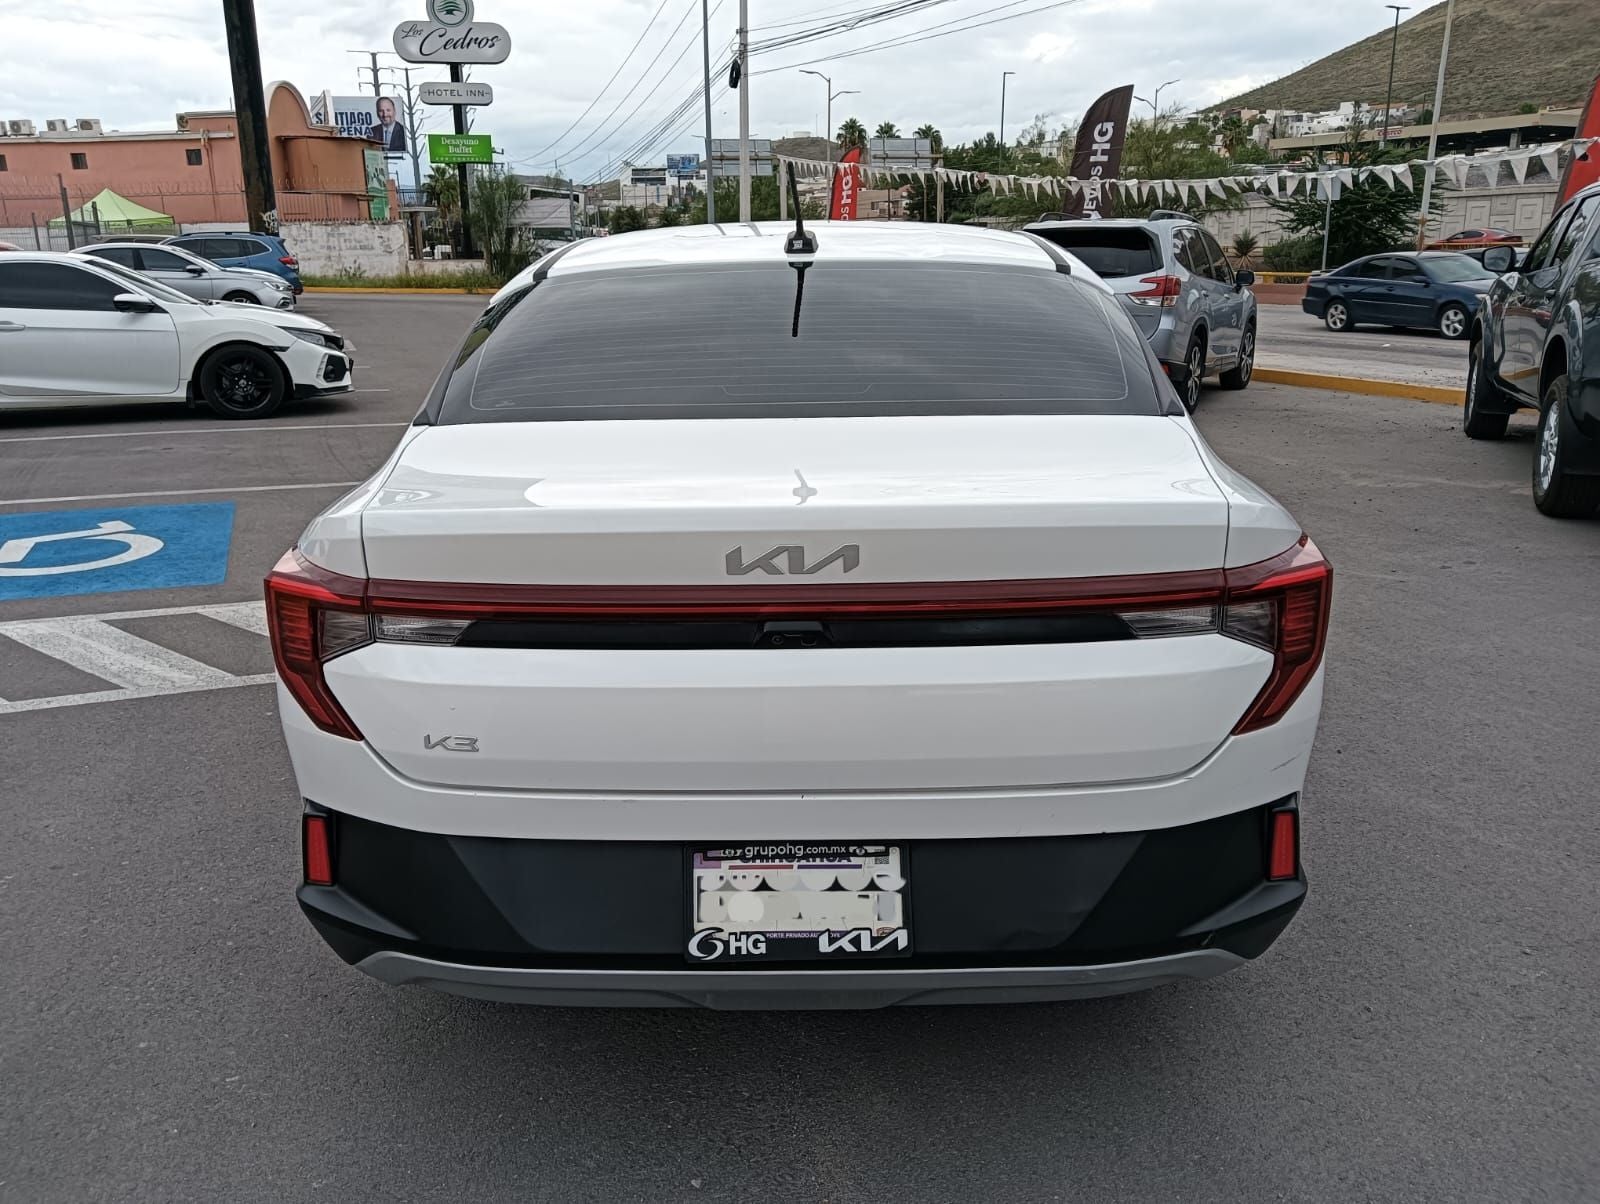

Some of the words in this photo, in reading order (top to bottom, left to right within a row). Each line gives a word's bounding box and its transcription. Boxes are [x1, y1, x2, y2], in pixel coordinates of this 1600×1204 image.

[401, 24, 424, 39] Los
[420, 27, 501, 56] Cedros
[315, 111, 373, 126] STIAGO
[441, 137, 479, 146] Desayuno
[1089, 121, 1114, 162] HG
[841, 175, 853, 204] HG
[725, 543, 860, 576] KIA
[424, 734, 480, 752] K3
[744, 842, 847, 858] grupohg.com.mx
[729, 933, 767, 955] HG
[819, 929, 908, 952] KIA
